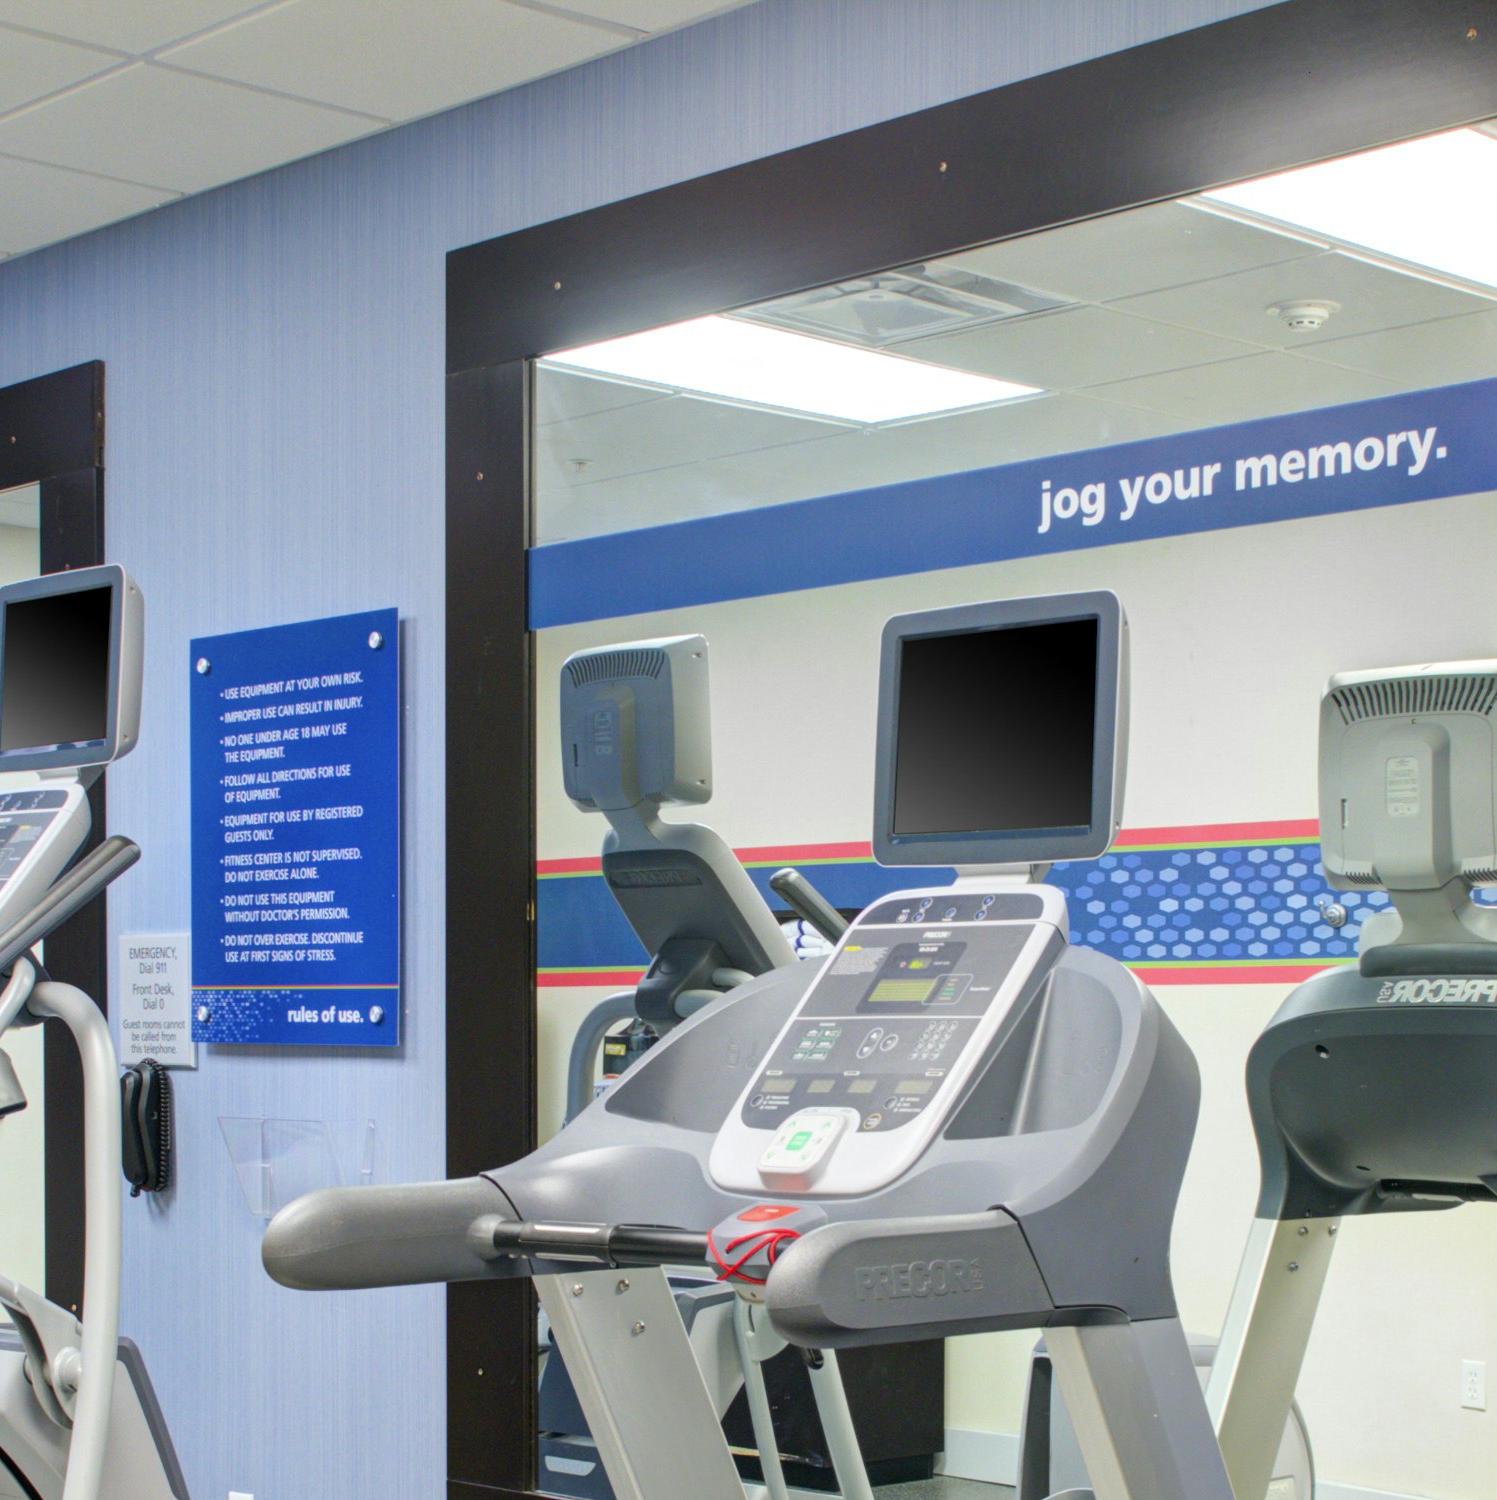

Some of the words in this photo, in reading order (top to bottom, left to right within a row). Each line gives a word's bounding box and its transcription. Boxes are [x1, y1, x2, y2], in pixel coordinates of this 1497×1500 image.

[1038, 480, 1106, 533] jog
[1119, 462, 1221, 521] your
[1234, 426, 1447, 491] memory.
[224, 688, 239, 700] USE
[240, 681, 284, 699] EQUIPMENT
[285, 679, 295, 692] AT
[296, 677, 320, 691] YOUR
[321, 673, 342, 688] OWN
[343, 671, 364, 684] RISK.
[224, 709, 261, 724] IMPROPER
[262, 706, 277, 719] USE
[277, 704, 294, 717] CAN
[295, 700, 323, 715] RESULT
[323, 700, 333, 712] IN
[334, 696, 363, 711] INJURY.
[224, 735, 237, 747] NO
[237, 733, 254, 746] ONE
[255, 730, 281, 744] UNDER
[282, 728, 299, 740] AGE
[301, 727, 311, 739] 18
[311, 724, 330, 738] MAY
[331, 722, 347, 735] USE
[224, 751, 239, 763] THE
[240, 746, 285, 763] EQUIPMENT.
[224, 774, 256, 787] FOLLOW
[256, 772, 271, 784] ALL
[271, 767, 317, 783] DIRECTIONS
[318, 766, 334, 778] FOR
[335, 764, 351, 777] USE
[224, 791, 235, 803] OF
[236, 787, 281, 804] EQUIPMENT.
[224, 812, 268, 829] EQUIPMENT
[269, 811, 285, 824] FOR
[286, 810, 301, 822] USE
[302, 809, 314, 821] BY
[315, 805, 364, 821] REGISTERED
[224, 831, 252, 843] GUESTS
[252, 829, 275, 842] ONLY.
[224, 854, 253, 867] FITNESS
[254, 852, 283, 866] CENTER
[284, 851, 292, 863] IS
[293, 850, 311, 863] NOT
[311, 847, 363, 862] SUPERVISED.
[224, 871, 237, 883] DO
[237, 871, 254, 883] NOT
[255, 868, 289, 882] EXERCISE
[290, 867, 320, 880] ALONE.
[224, 895, 237, 907] DO
[237, 894, 254, 906] NOT
[255, 893, 269, 905] USE
[270, 893, 288, 905] THIS
[288, 890, 335, 906] EQUIPMENT
[224, 910, 260, 923] WITHOUT
[260, 909, 300, 922] DOCTOR'S
[300, 907, 350, 920] PERMISSION.
[224, 935, 237, 946] DO
[237, 934, 253, 946] NOT
[254, 934, 275, 946] OVER
[275, 933, 311, 945] EXERCISE.
[311, 931, 364, 944] DISCONTINUE
[129, 947, 177, 960] EMERGENCY,
[225, 951, 239, 963] USE
[239, 951, 249, 962] AT
[250, 950, 271, 962] FIRST
[271, 950, 294, 962] SIGNS
[295, 949, 306, 962] OF
[307, 949, 336, 962] STRESS.
[139, 962, 154, 974] Dial
[155, 962, 167, 974] 911
[132, 983, 152, 995] Front
[154, 983, 175, 996] Desk,
[142, 998, 158, 1010] Dial
[159, 998, 164, 1010] 0
[287, 1005, 319, 1023] rules
[321, 1005, 336, 1023] of
[338, 1009, 364, 1023] use.
[122, 1019, 141, 1029] Guest
[142, 1021, 162, 1029] rooms
[163, 1020, 186, 1029] cannot
[131, 1031, 140, 1042] be
[141, 1031, 159, 1042] called
[161, 1031, 177, 1041] from
[131, 1044, 142, 1053] this
[143, 1044, 177, 1055] telephone.
[854, 1259, 971, 1301] PRECOR
